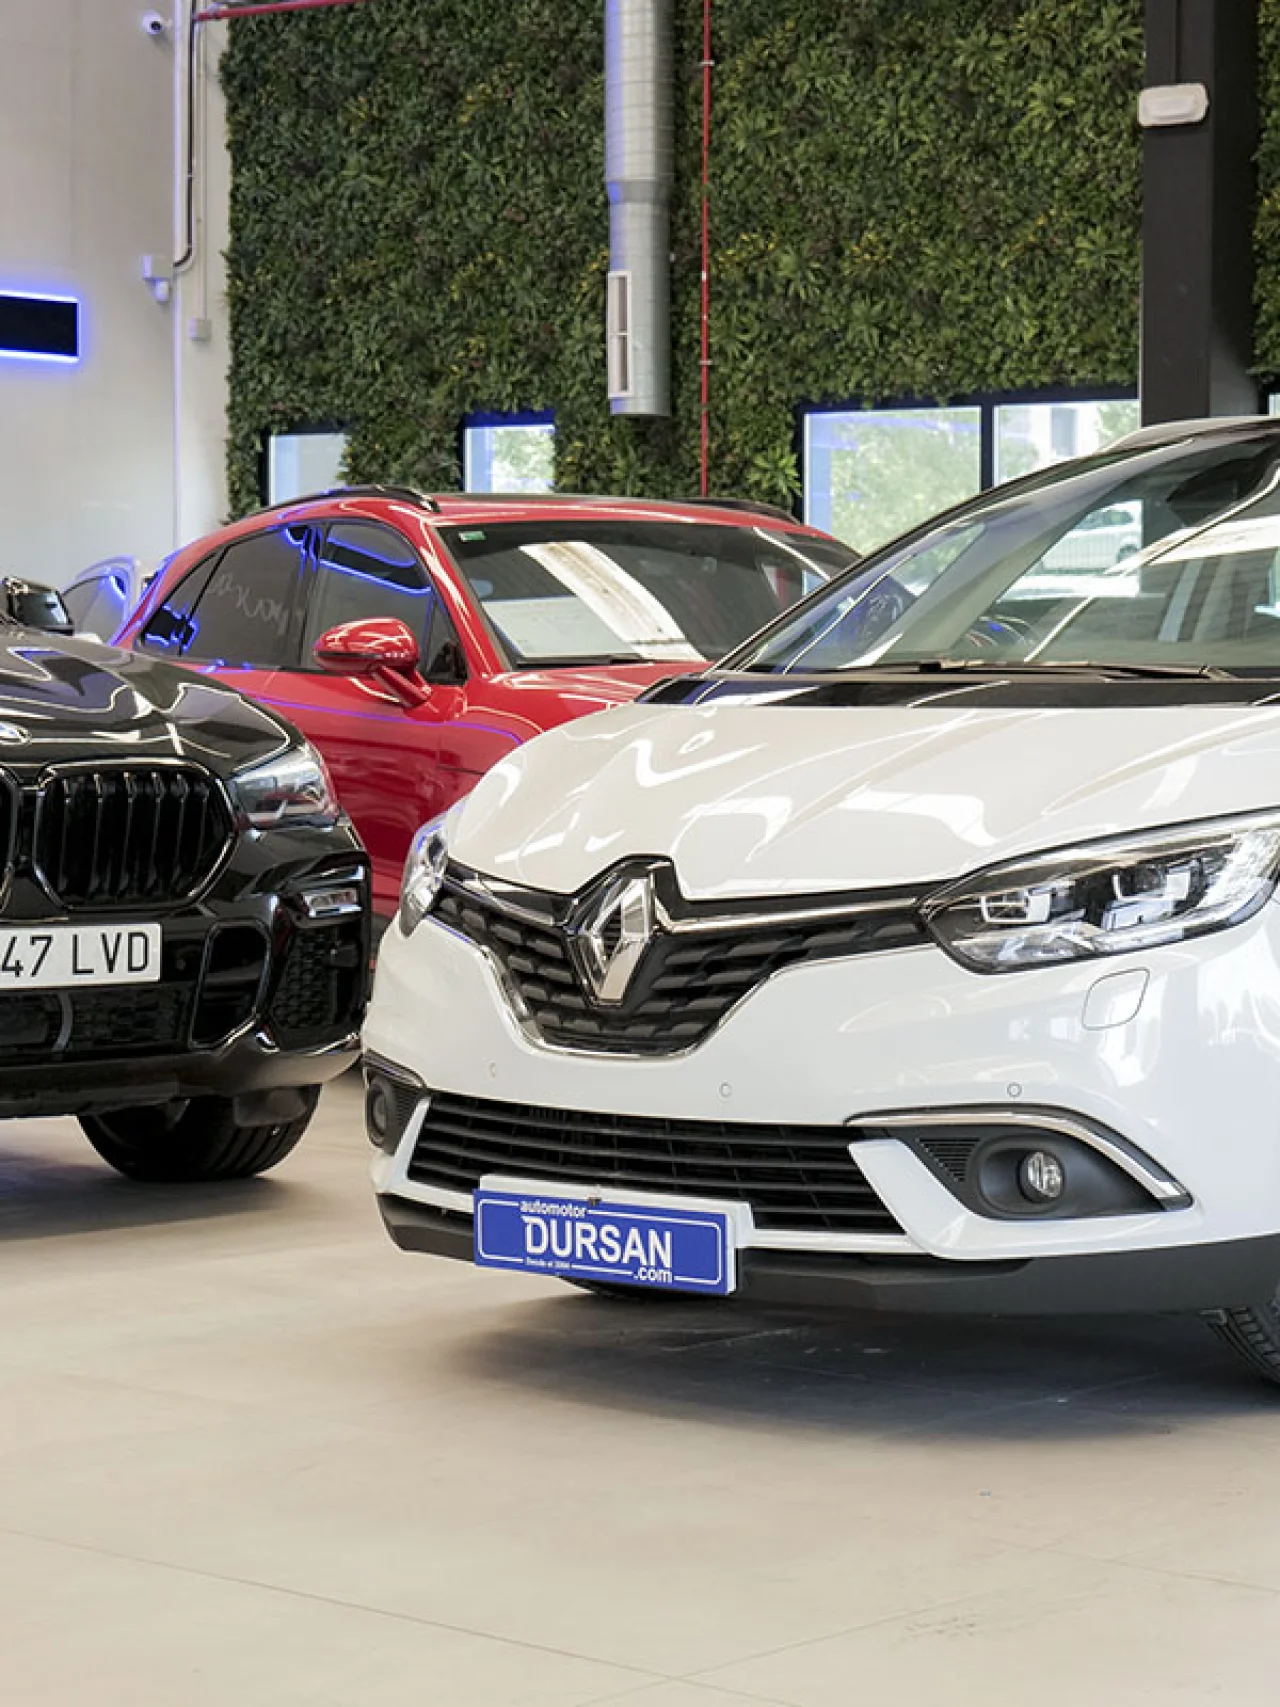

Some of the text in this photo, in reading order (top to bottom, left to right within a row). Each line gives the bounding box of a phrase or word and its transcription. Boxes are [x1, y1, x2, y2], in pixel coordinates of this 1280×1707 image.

[0, 931, 149, 978] 47 LVD
[519, 1200, 587, 1218] automotor
[522, 1216, 673, 1268] DURSAN
[633, 1267, 673, 1284] .com
